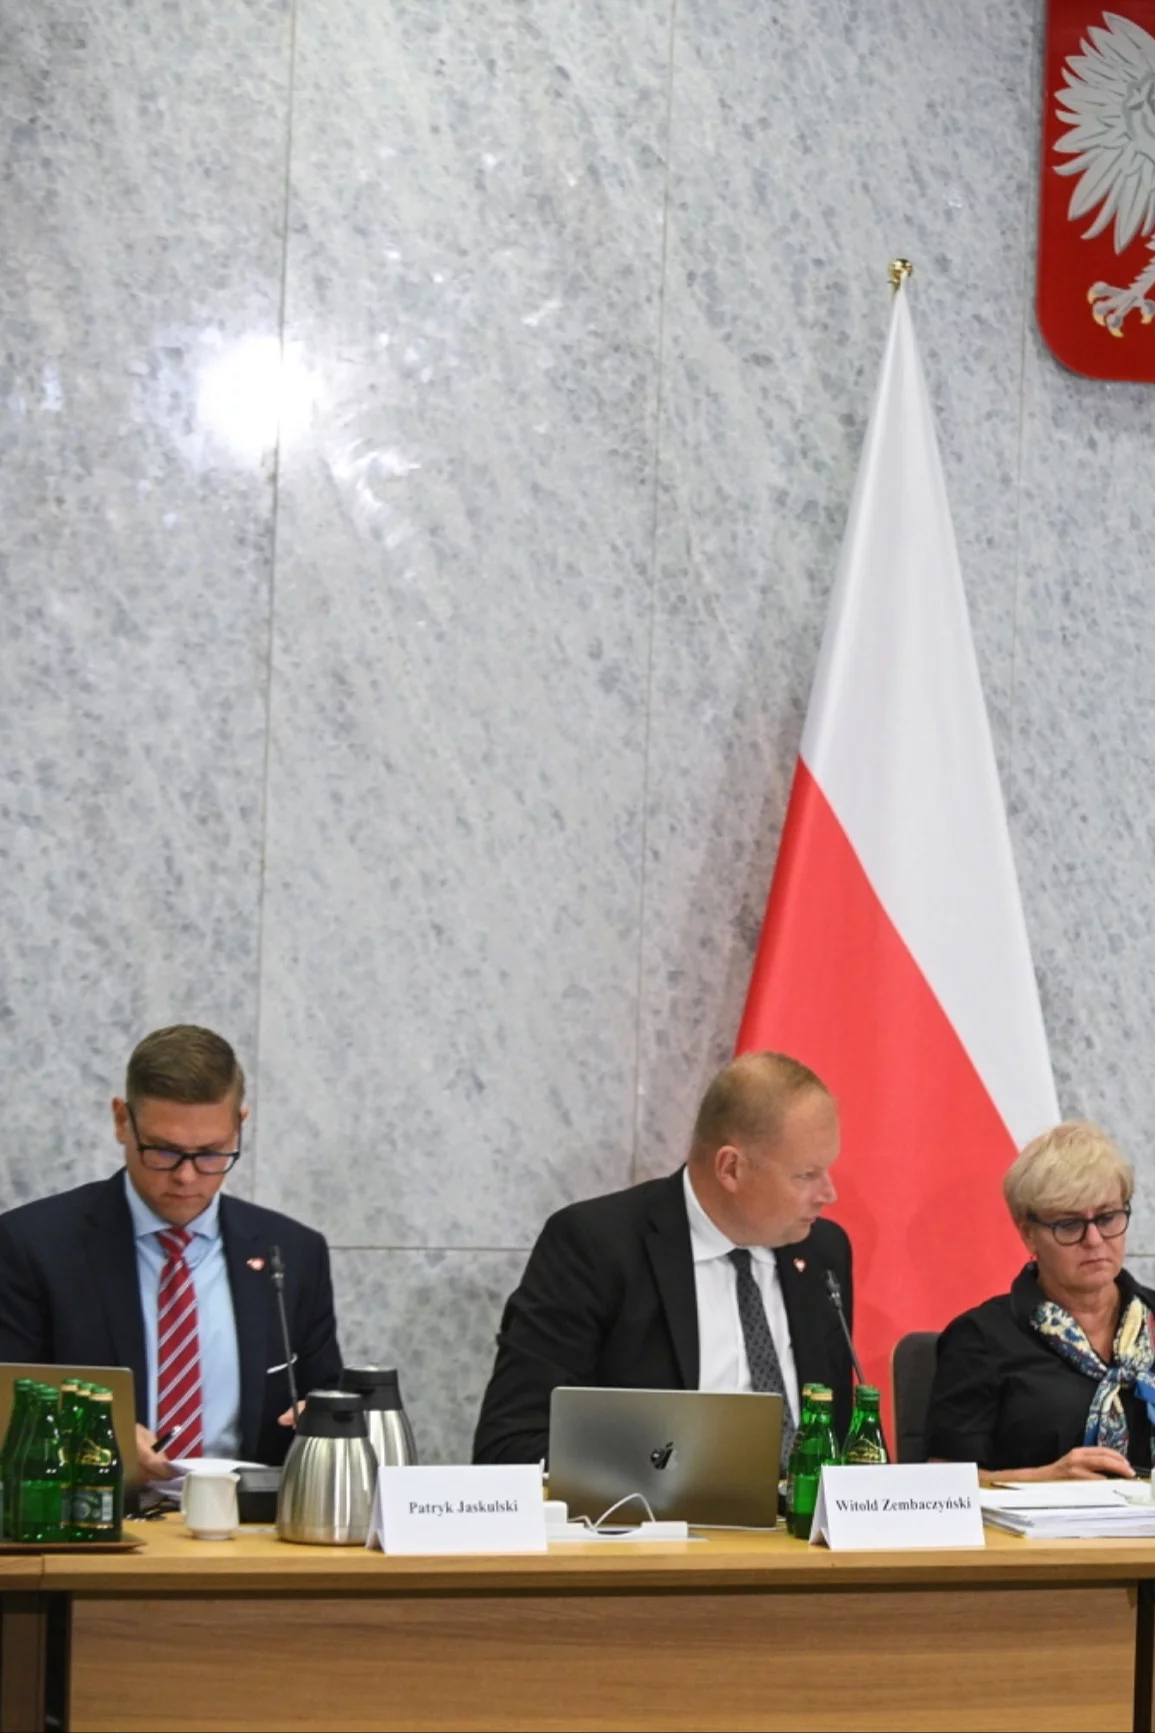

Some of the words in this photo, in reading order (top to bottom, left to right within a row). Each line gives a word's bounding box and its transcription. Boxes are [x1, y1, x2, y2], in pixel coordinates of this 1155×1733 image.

[408, 1501, 453, 1516] Patryk
[457, 1500, 519, 1513] Jaskulski
[836, 1499, 879, 1512] Witold
[882, 1497, 972, 1513] Zembaczyński
